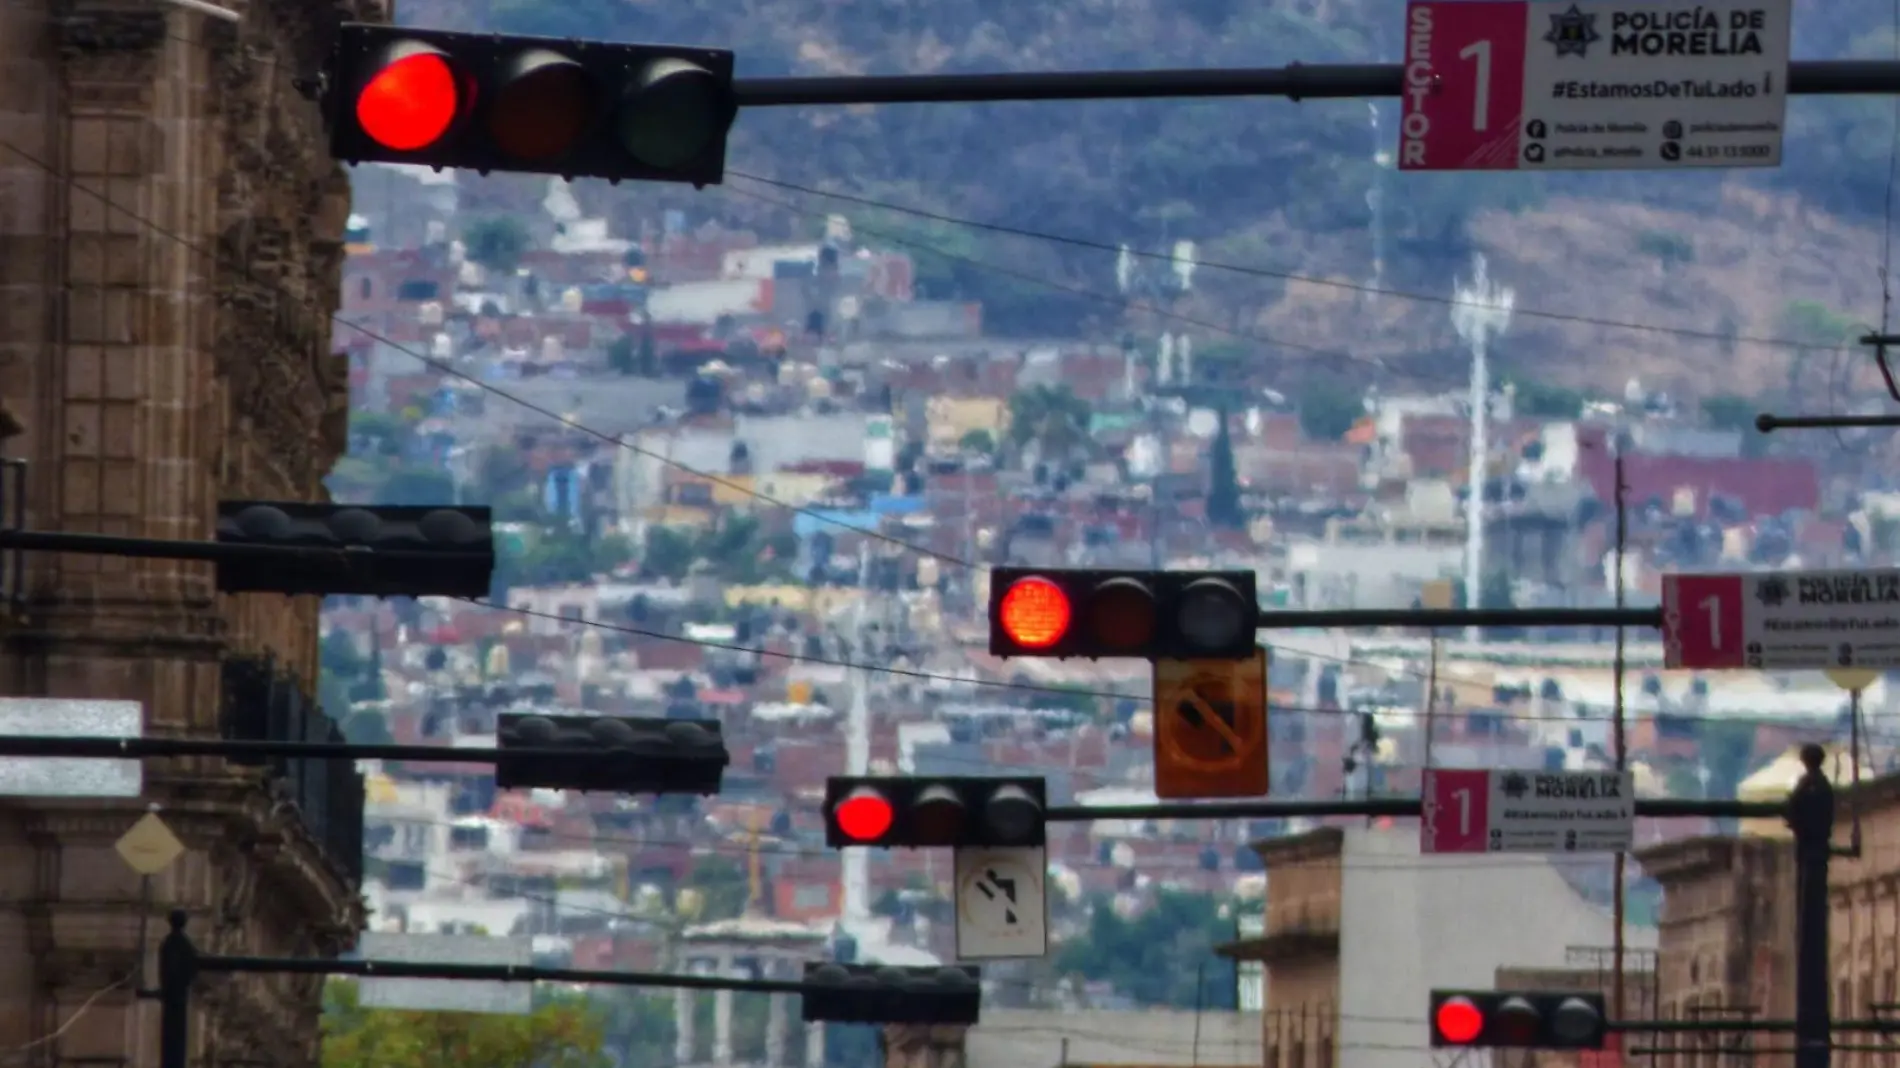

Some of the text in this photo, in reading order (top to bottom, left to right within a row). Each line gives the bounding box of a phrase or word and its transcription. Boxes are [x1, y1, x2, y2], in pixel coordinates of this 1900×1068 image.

[1611, 6, 1766, 31] POLICÍA DE
[1611, 32, 1764, 56] MORELIA
[1403, 6, 1432, 165] SECTOR
[1459, 38, 1492, 132] 1
[1552, 78, 1757, 99] #EstamosDeTuLado
[1799, 587, 1900, 604] MORELIA
[1697, 593, 1722, 650] 1
[1450, 787, 1471, 841] 1
